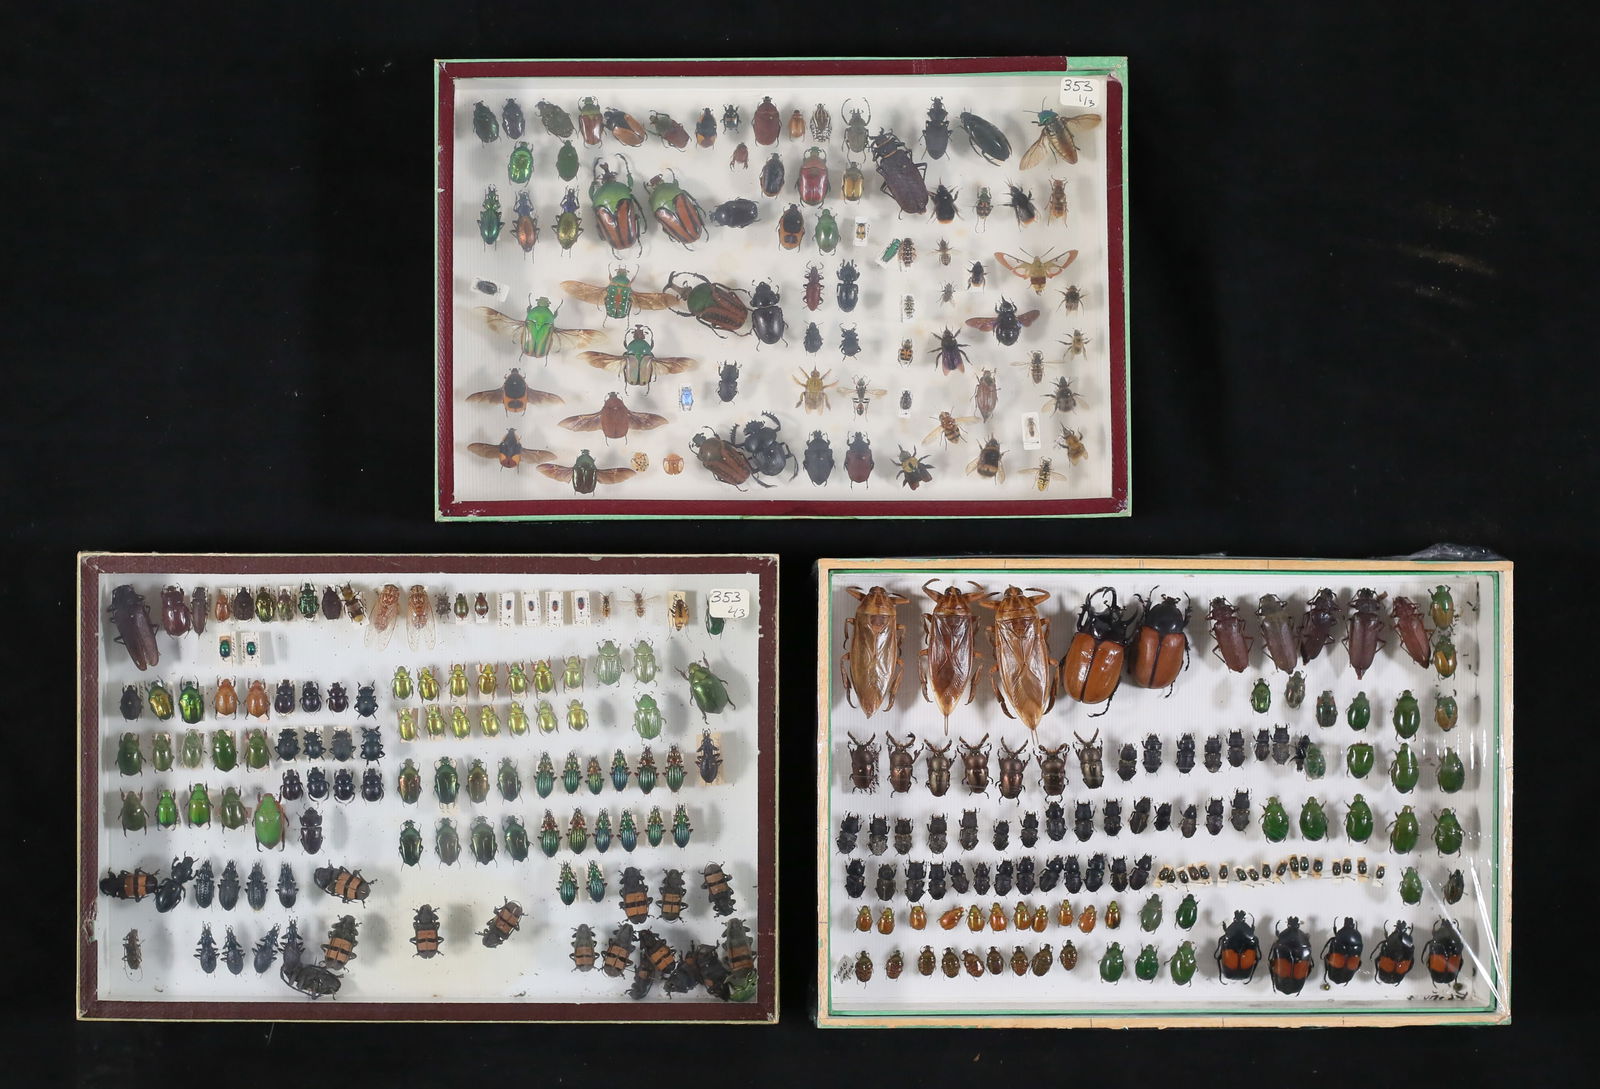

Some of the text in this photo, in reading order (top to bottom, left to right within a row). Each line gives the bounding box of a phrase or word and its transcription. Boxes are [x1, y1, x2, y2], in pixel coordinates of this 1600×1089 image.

[1064, 79, 1093, 92] 353
[1078, 94, 1095, 107] 1/3
[711, 590, 741, 603] 353
